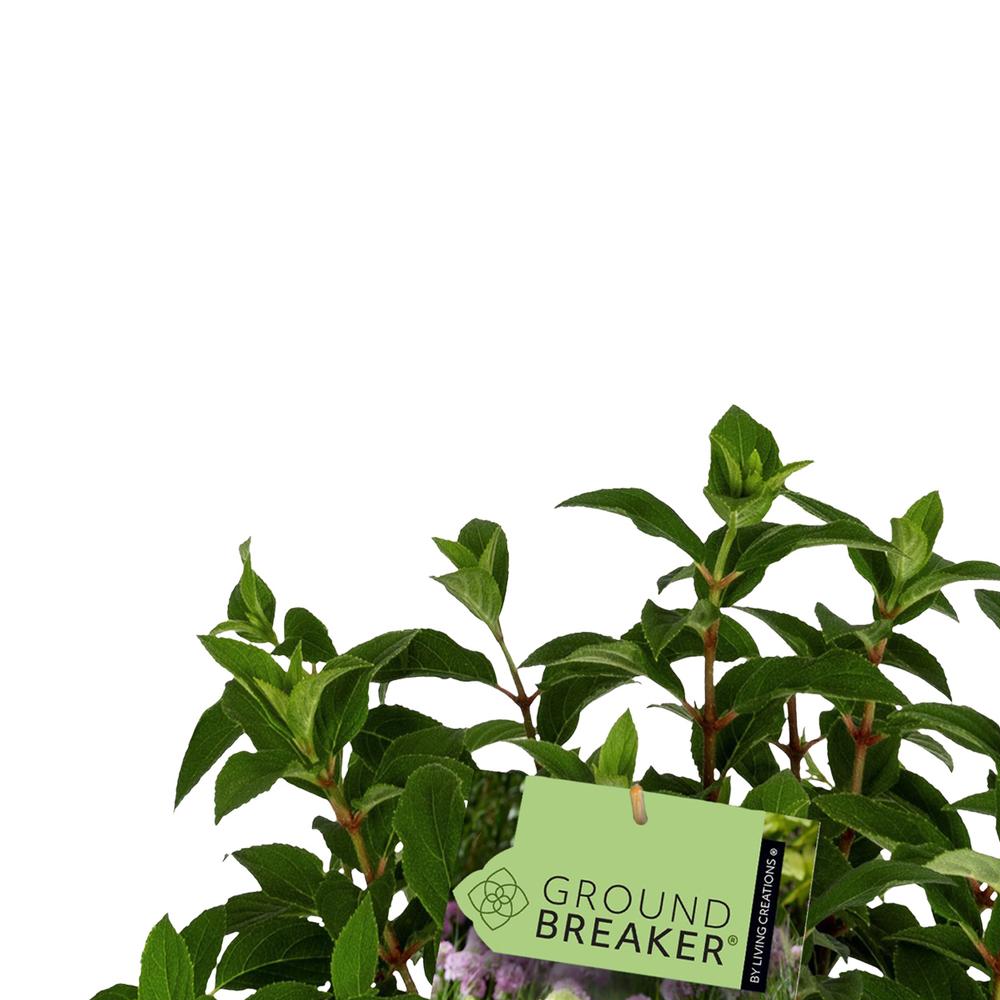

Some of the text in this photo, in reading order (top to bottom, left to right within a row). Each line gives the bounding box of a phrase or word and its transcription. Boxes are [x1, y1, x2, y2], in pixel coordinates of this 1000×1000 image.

[543, 876, 731, 929] GROUND
[752, 926, 767, 966] LIVING
[750, 968, 761, 983] BY
